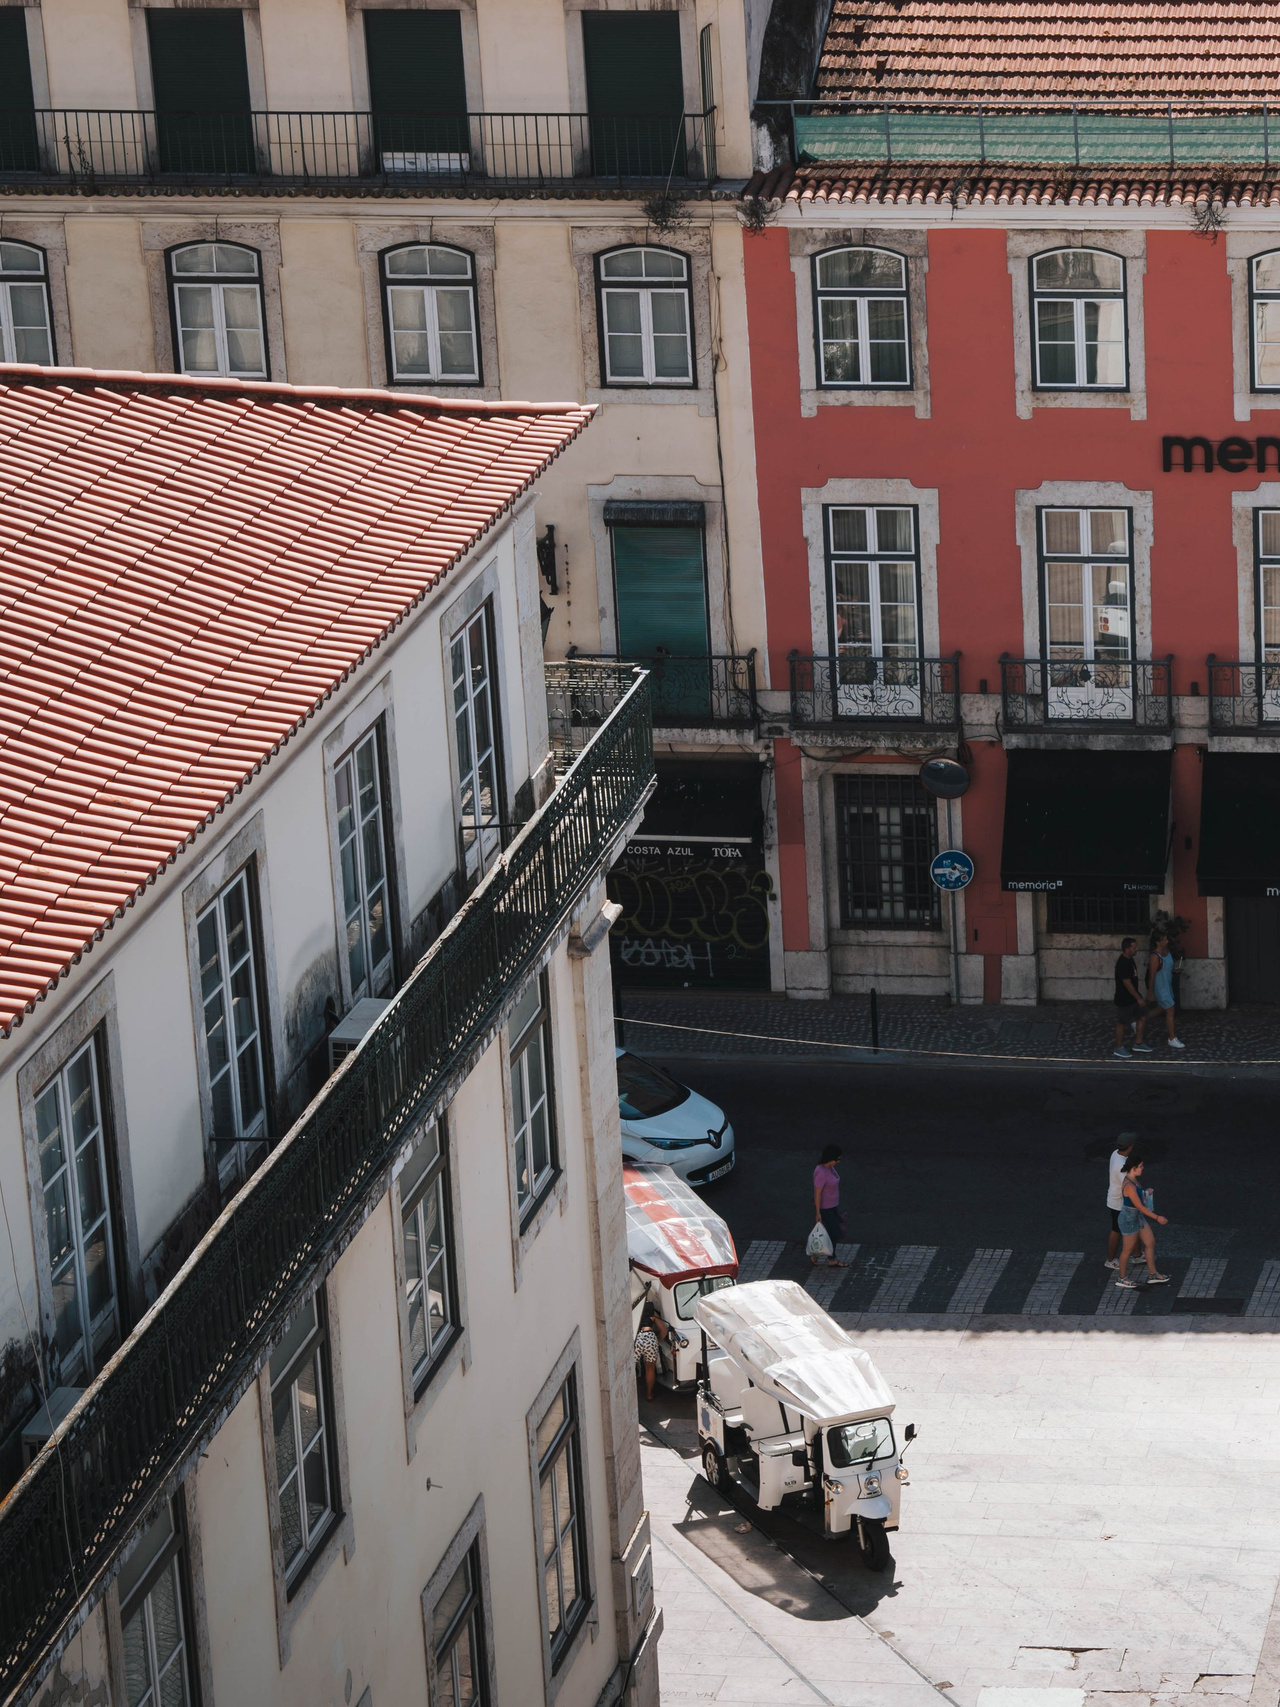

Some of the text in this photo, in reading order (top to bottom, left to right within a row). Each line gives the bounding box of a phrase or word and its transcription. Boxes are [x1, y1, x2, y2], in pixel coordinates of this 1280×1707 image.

[626, 846, 694, 856] COSTA AZUL
[712, 848, 742, 858] TOFA
[1008, 880, 1056, 890] memória
